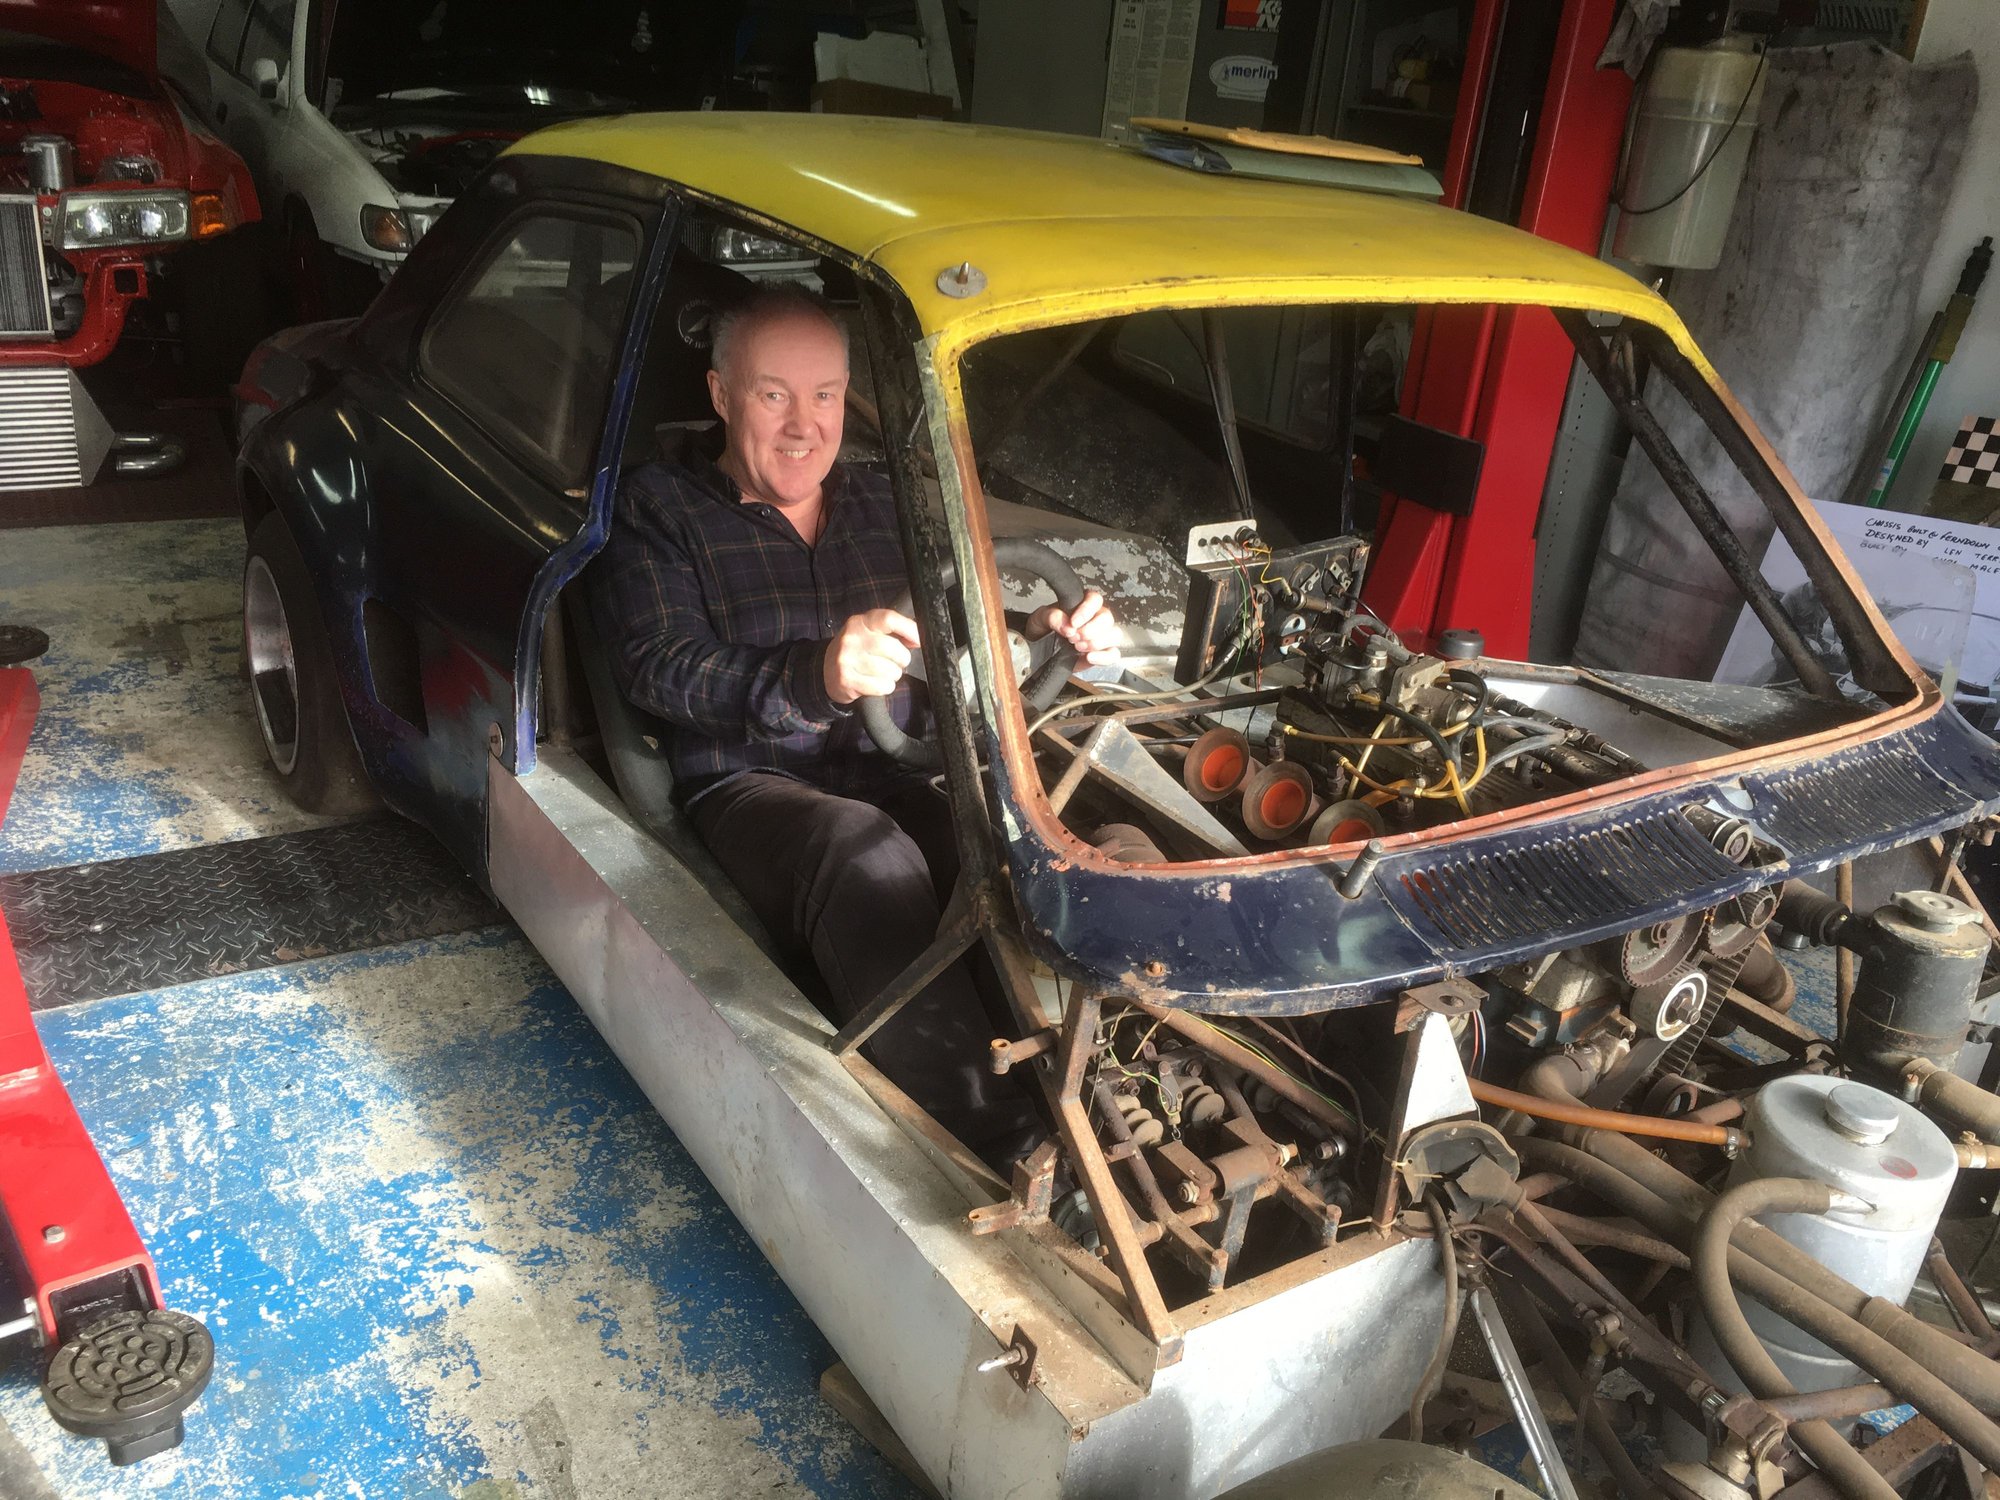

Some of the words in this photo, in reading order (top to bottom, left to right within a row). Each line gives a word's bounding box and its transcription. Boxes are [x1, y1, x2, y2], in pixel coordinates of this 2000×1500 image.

[1231, 65, 1277, 79] merlin
[1865, 518, 1901, 530] CHASSIS
[1865, 529, 1914, 543] DESIGNED
[1916, 539, 1929, 548] BY
[1944, 547, 1962, 555] LEN
[1975, 553, 2000, 563] TERR
